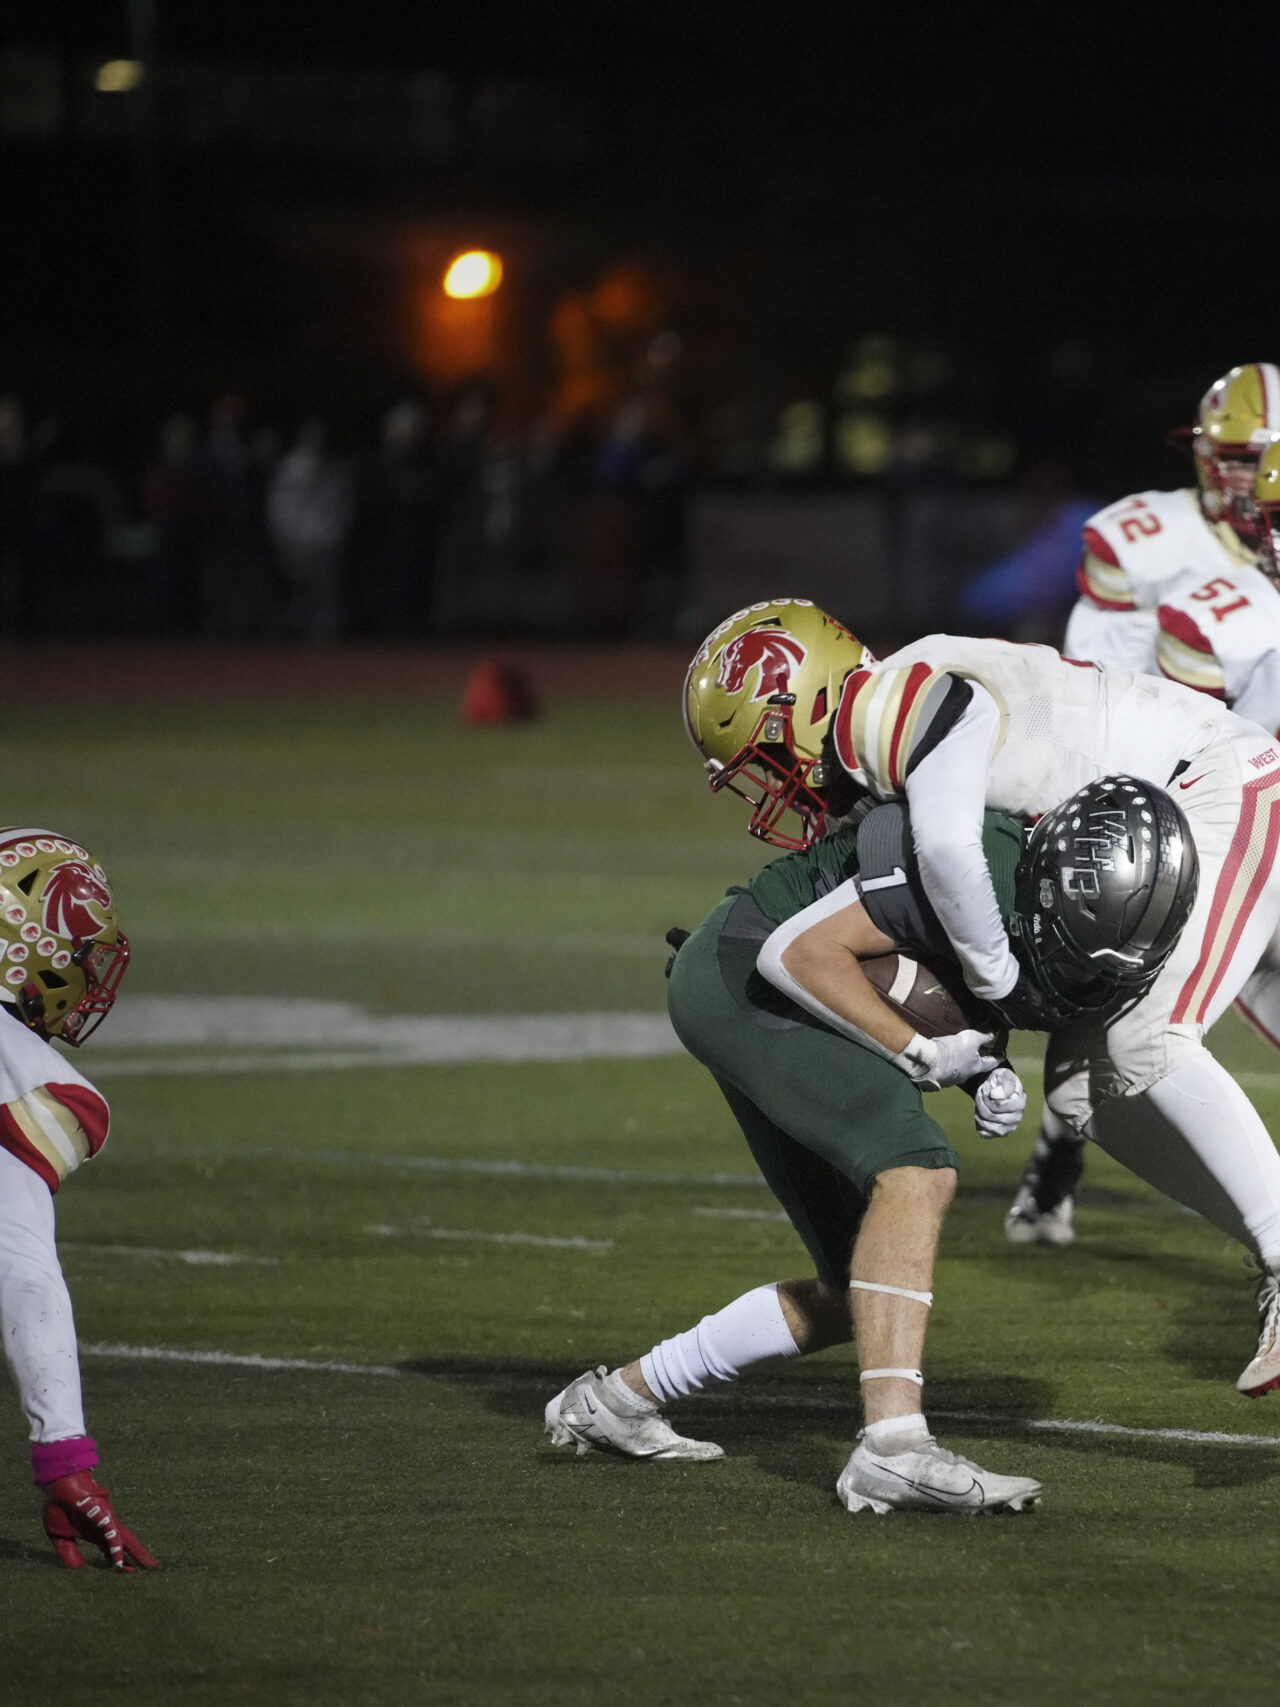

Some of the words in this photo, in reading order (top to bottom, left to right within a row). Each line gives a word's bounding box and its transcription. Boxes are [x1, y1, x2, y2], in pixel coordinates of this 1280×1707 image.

[1189, 577, 1252, 623] 51
[1247, 747, 1280, 770] WEST
[860, 866, 908, 893] 1
